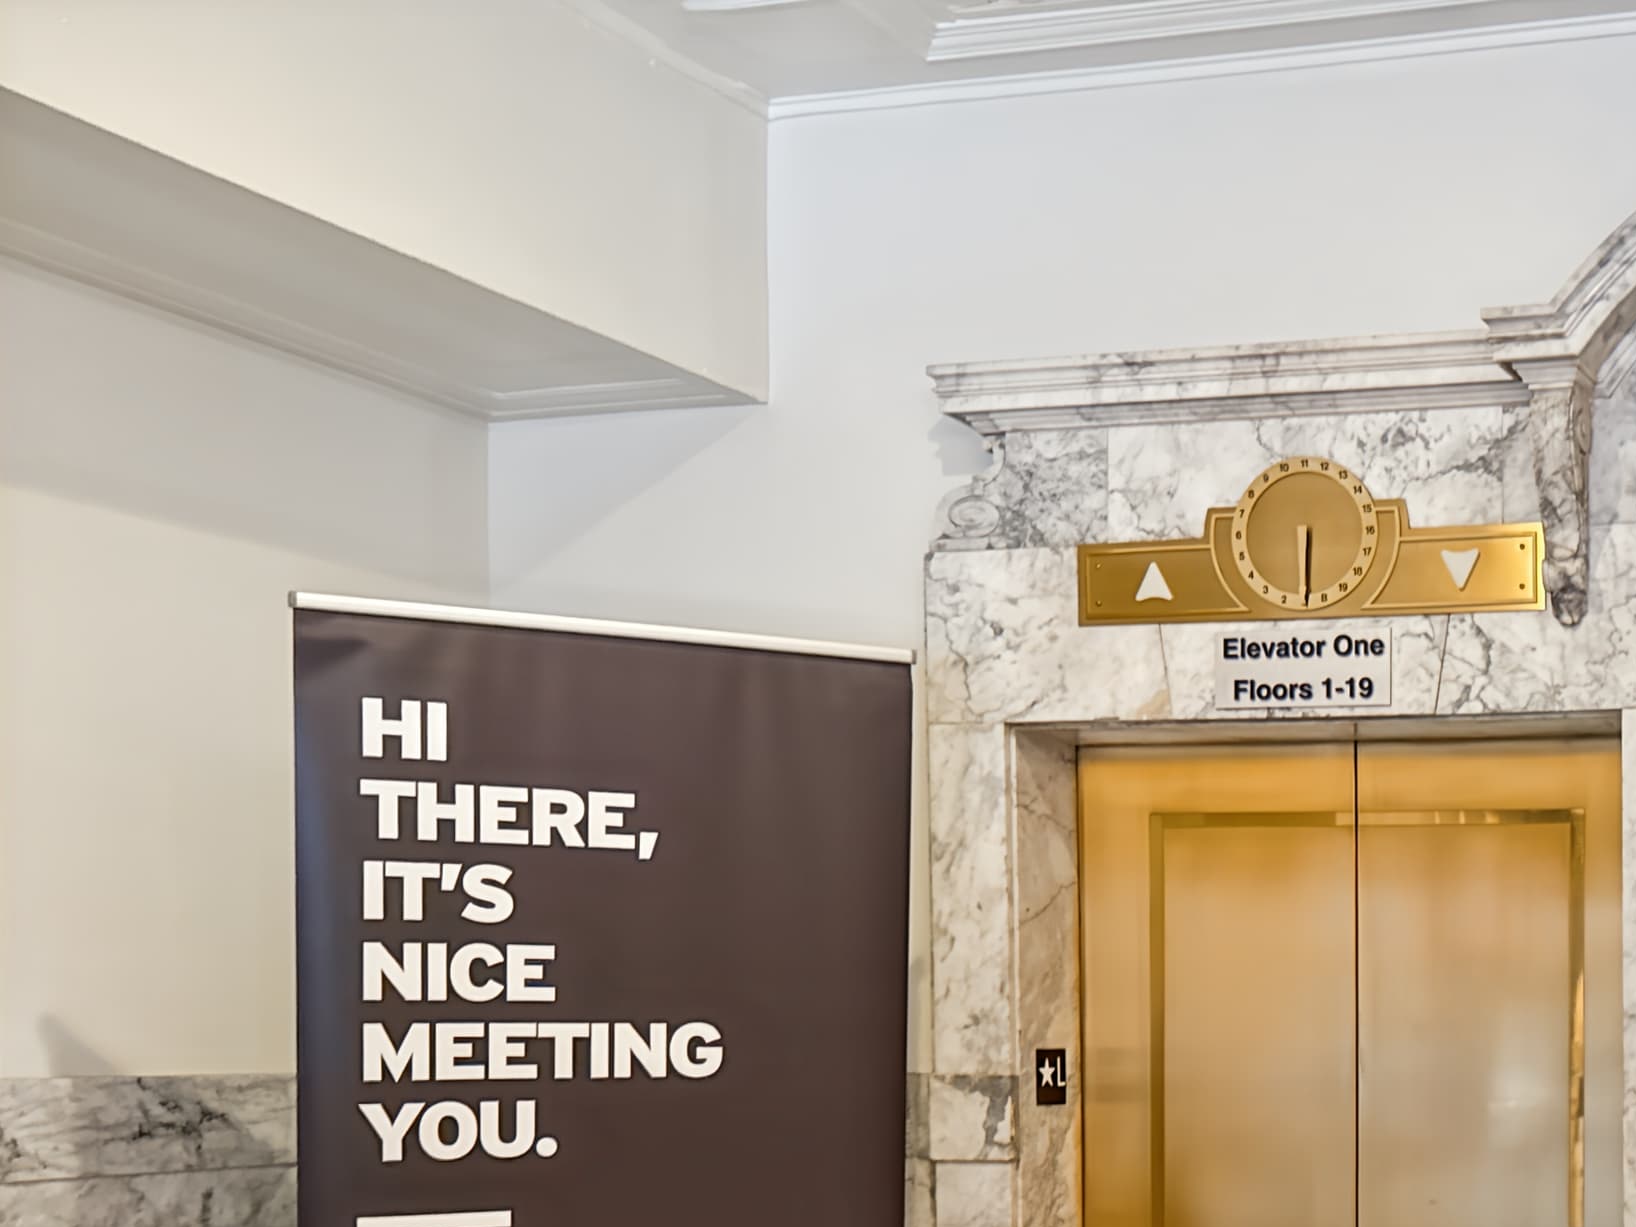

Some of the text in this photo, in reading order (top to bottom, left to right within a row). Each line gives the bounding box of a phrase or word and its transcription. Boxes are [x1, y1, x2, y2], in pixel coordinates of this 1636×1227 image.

[1301, 459, 1308, 467] 11
[1320, 462, 1329, 470] 12
[1280, 464, 1289, 472] 10
[1263, 473, 1269, 482] 9
[1339, 470, 1348, 479] 13
[1248, 490, 1254, 498] 8
[1353, 485, 1362, 494] 14
[1362, 504, 1372, 513] 15
[1239, 509, 1245, 518] 7
[1365, 526, 1375, 534] 16
[1235, 531, 1242, 540] 6
[1239, 552, 1245, 560] 5
[1363, 547, 1372, 556] 17
[1248, 571, 1254, 579] 4
[1353, 567, 1362, 576] 18
[1263, 585, 1269, 594] 3
[1339, 583, 1348, 592] 19
[1281, 595, 1287, 604] 2
[1223, 634, 1384, 659] Elevator One
[1234, 677, 1373, 701] Floors 1-19
[362, 697, 447, 761] HI
[359, 778, 659, 860] THERE,
[362, 860, 514, 924] IT'S
[362, 942, 556, 1002] NICE
[362, 1021, 723, 1082] MEETING
[358, 1100, 558, 1162] YOU.
